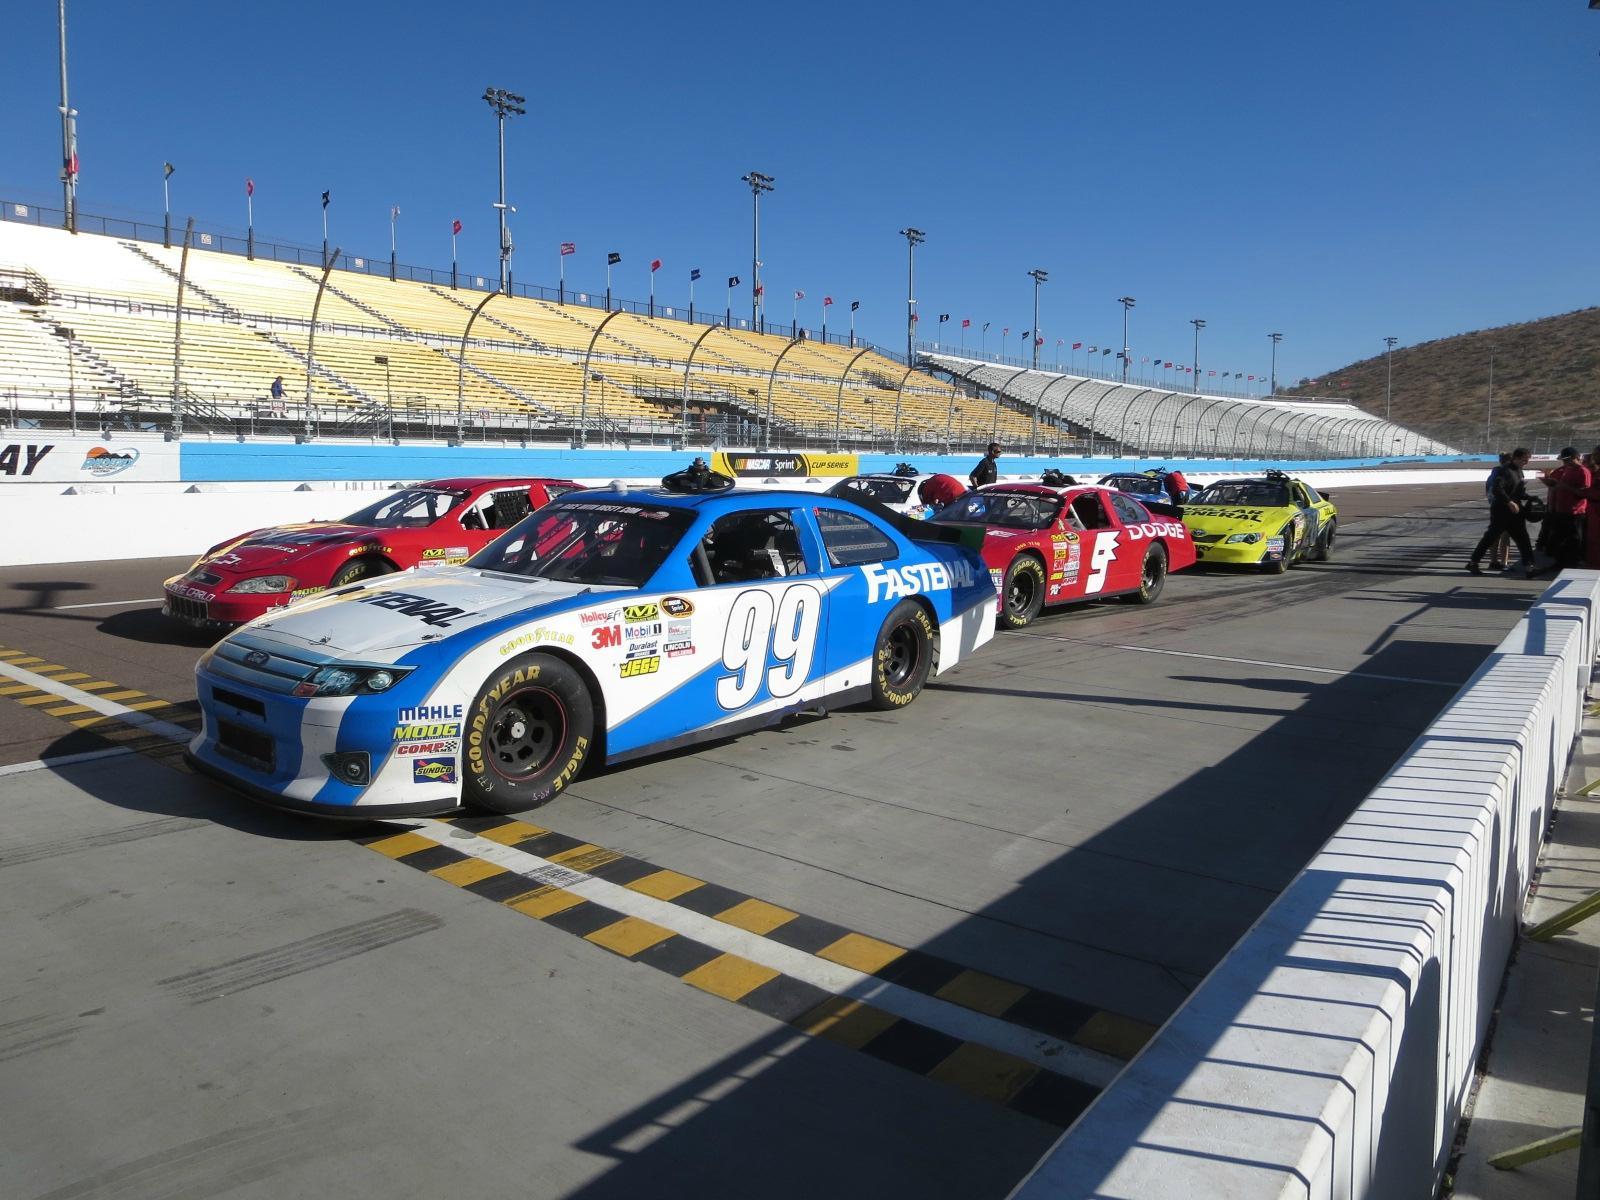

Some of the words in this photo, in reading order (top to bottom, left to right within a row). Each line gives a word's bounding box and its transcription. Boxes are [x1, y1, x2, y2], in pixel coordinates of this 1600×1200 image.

[745, 459, 770, 470] NASCAR
[775, 459, 795, 473] Sprint
[812, 461, 826, 469] CUP
[826, 461, 849, 469] SERIES
[1184, 511, 1262, 523] ENERAL
[1125, 523, 1185, 540] DODGE
[860, 560, 975, 604] FASTENAL
[579, 611, 608, 623] Holley
[625, 625, 651, 639] Mobil
[653, 623, 662, 634] 1
[915, 611, 933, 640] EAGLE
[499, 628, 575, 655] GOODYEAR
[592, 625, 621, 649] 3M
[629, 640, 658, 651] Duralast
[664, 642, 691, 652] LINCOLN
[716, 584, 822, 711] 99
[620, 656, 660, 678] JEGS
[878, 649, 913, 705] GOODYEAR
[399, 705, 462, 721] MAHLE
[469, 664, 541, 775] GOODYEAR
[393, 723, 458, 739] MOOG
[397, 742, 445, 755] COMP
[417, 766, 452, 775] SUNOCO
[553, 736, 588, 792] EAGLE
